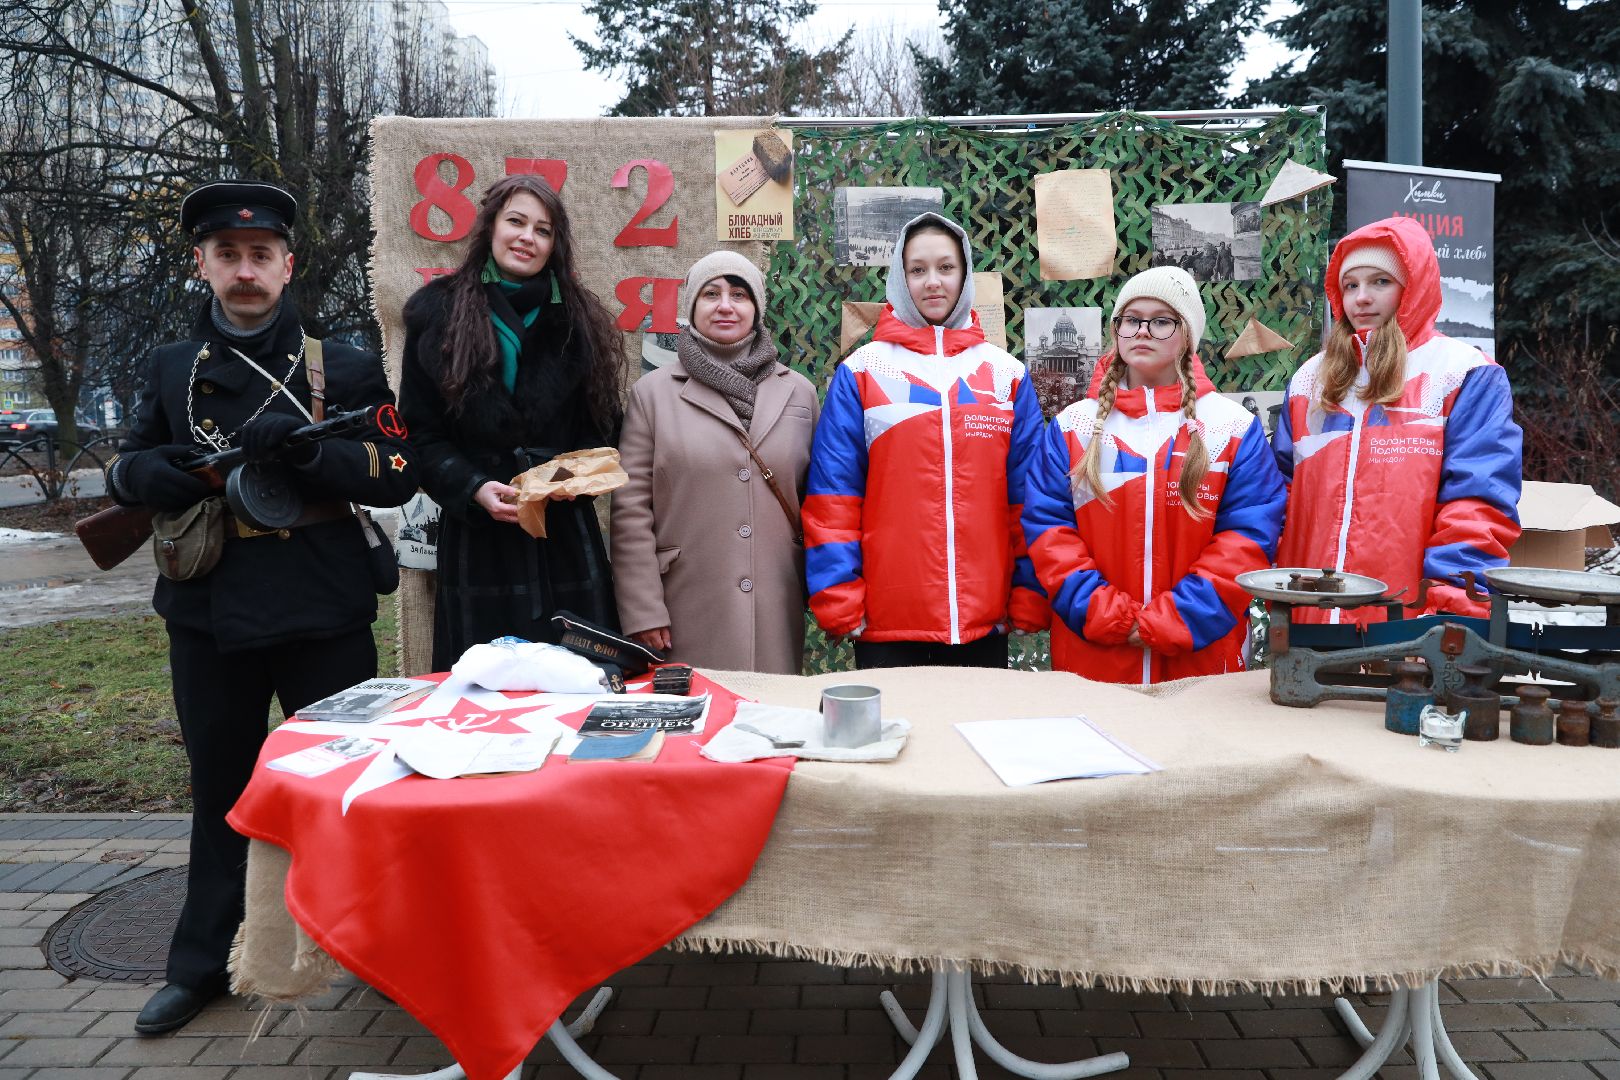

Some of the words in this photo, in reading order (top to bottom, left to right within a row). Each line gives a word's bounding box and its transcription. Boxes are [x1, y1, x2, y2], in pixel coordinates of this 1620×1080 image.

[1404, 178, 1446, 203] Химки
[728, 212, 783, 227] БЛОКАДНЫЙ
[1391, 211, 1464, 240] ЦИЯ
[728, 227, 751, 239] ХЛЕБ
